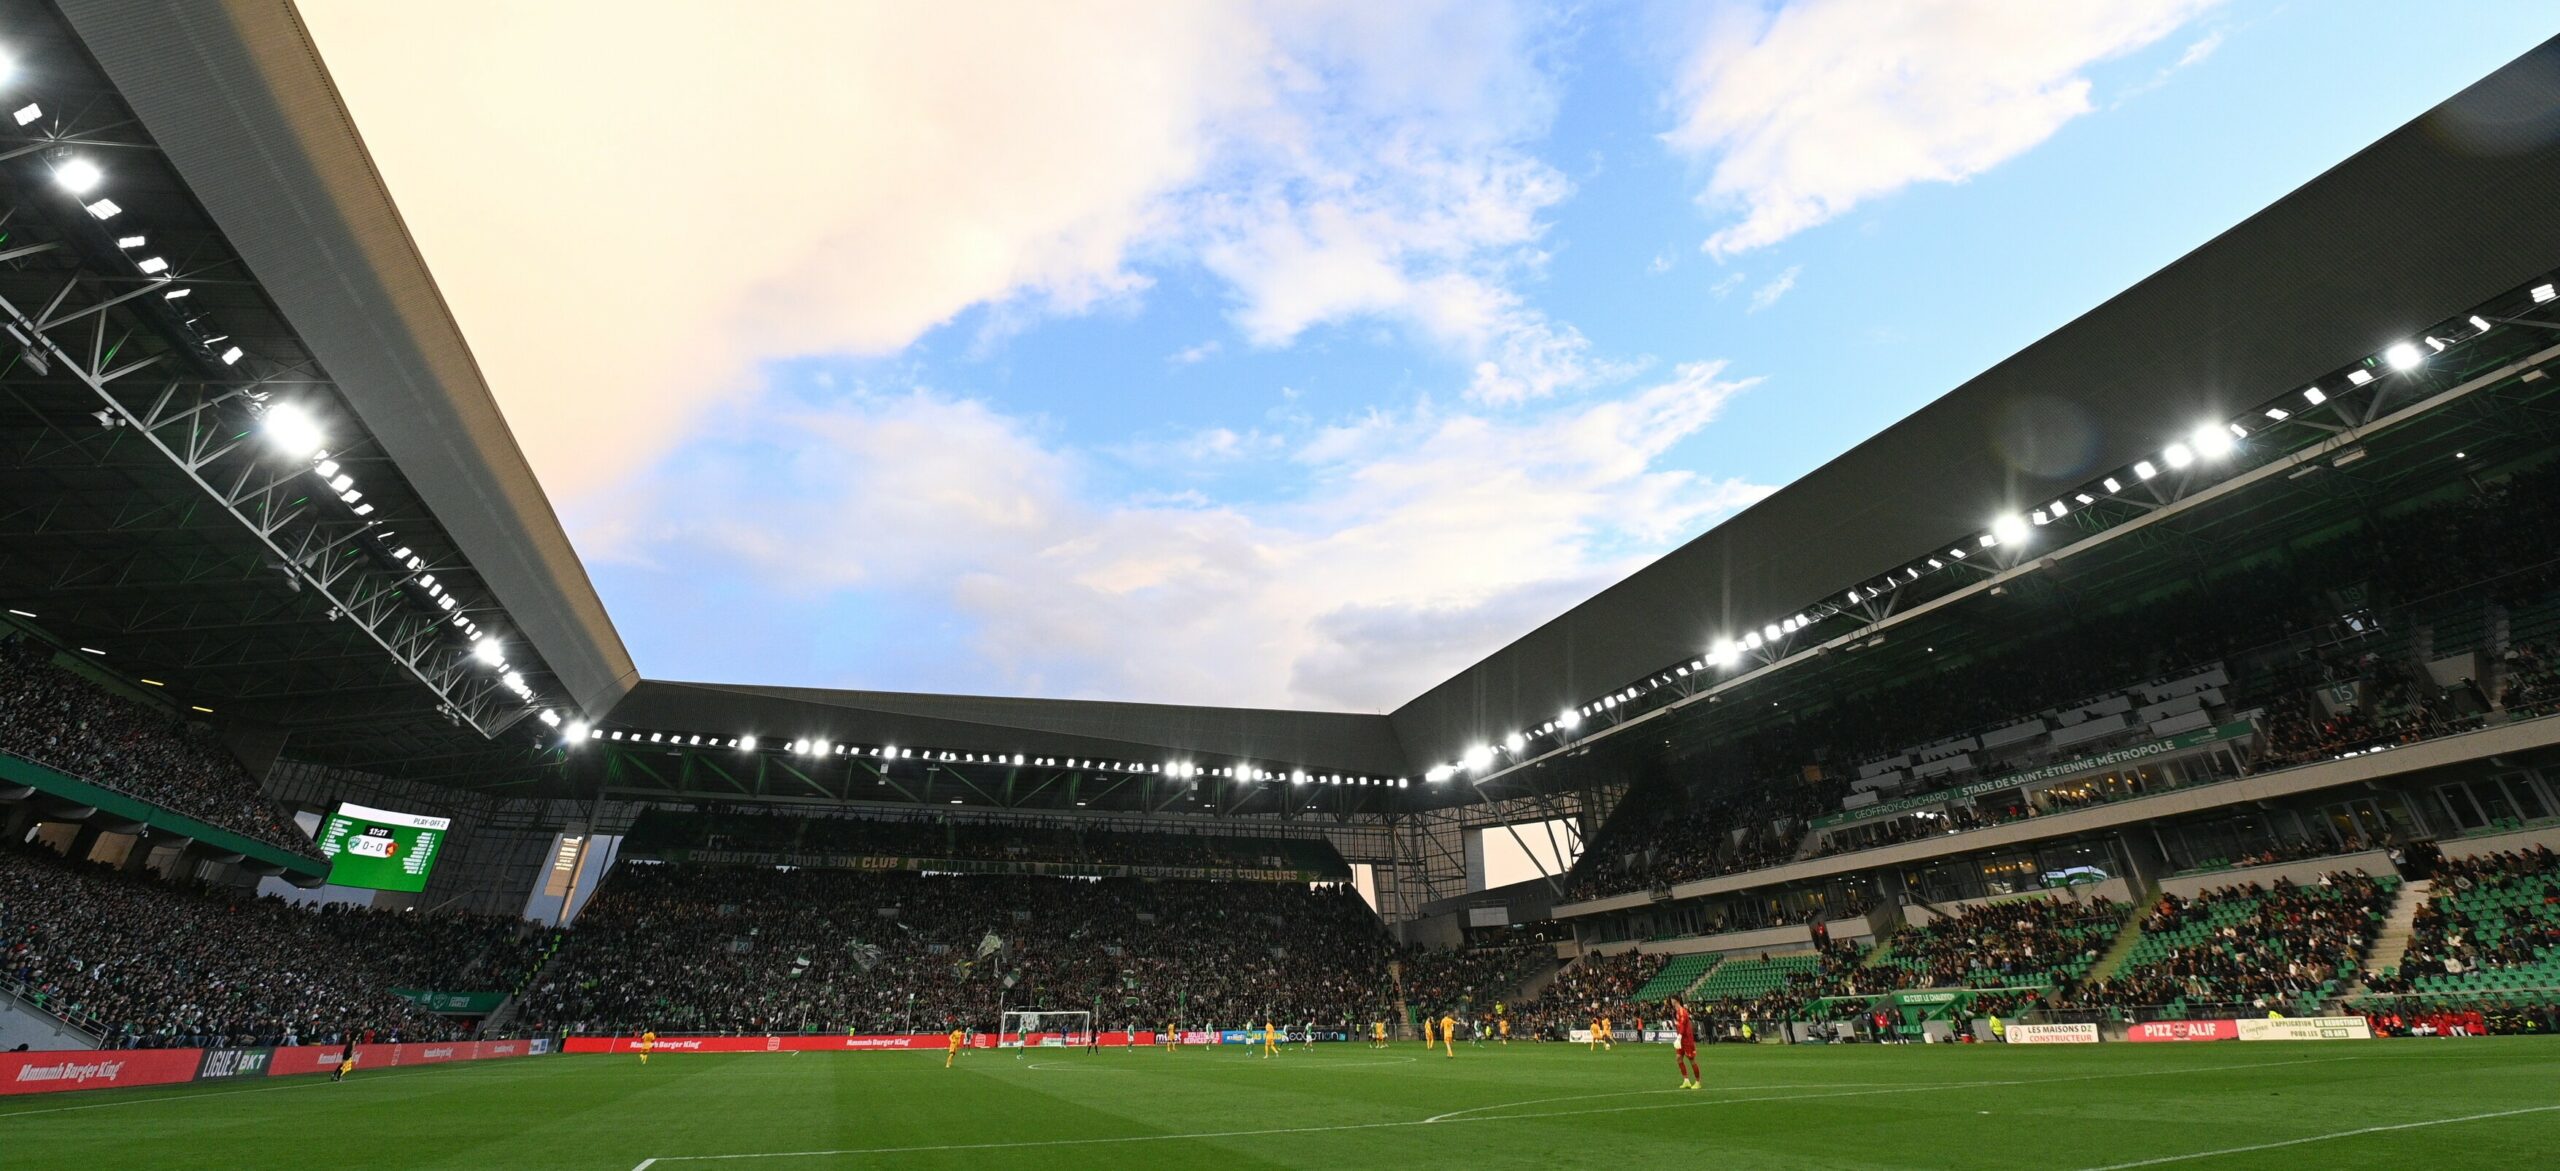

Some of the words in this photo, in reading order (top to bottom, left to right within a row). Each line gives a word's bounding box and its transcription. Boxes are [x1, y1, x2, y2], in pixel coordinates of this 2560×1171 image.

[2331, 685, 2353, 702] 15
[1962, 782, 1994, 797] STADE
[1995, 778, 2011, 791] DE
[2011, 758, 2095, 787] SAINT-ÉTIENNE
[2097, 739, 2175, 769] MÉTROPOLE
[1854, 791, 1949, 820] GEOFFROY-GUICHARD
[687, 849, 780, 865] COMBATTRE
[785, 853, 823, 867] POUR
[828, 855, 857, 869] SON
[861, 856, 899, 869] CLUB
[1133, 866, 1205, 879] RESPECTER
[1210, 868, 1233, 879] SES
[1236, 868, 1298, 881] COULEURS
[2027, 1026, 2042, 1034] LES
[2042, 1025, 2079, 1033] MAISONS
[2144, 1023, 2173, 1037] PIZZ
[2188, 1022, 2217, 1036] ALIF
[660, 1041, 682, 1050] Burger
[683, 1040, 702, 1049] King
[873, 1039, 894, 1047] Burger
[895, 1038, 911, 1047] King
[2029, 1034, 2092, 1042] CONSTRUCTEUR
[61, 1062, 98, 1083] Burger
[96, 1059, 122, 1081] King
[202, 1050, 235, 1078] LIGUE
[238, 1053, 267, 1071] BKT
